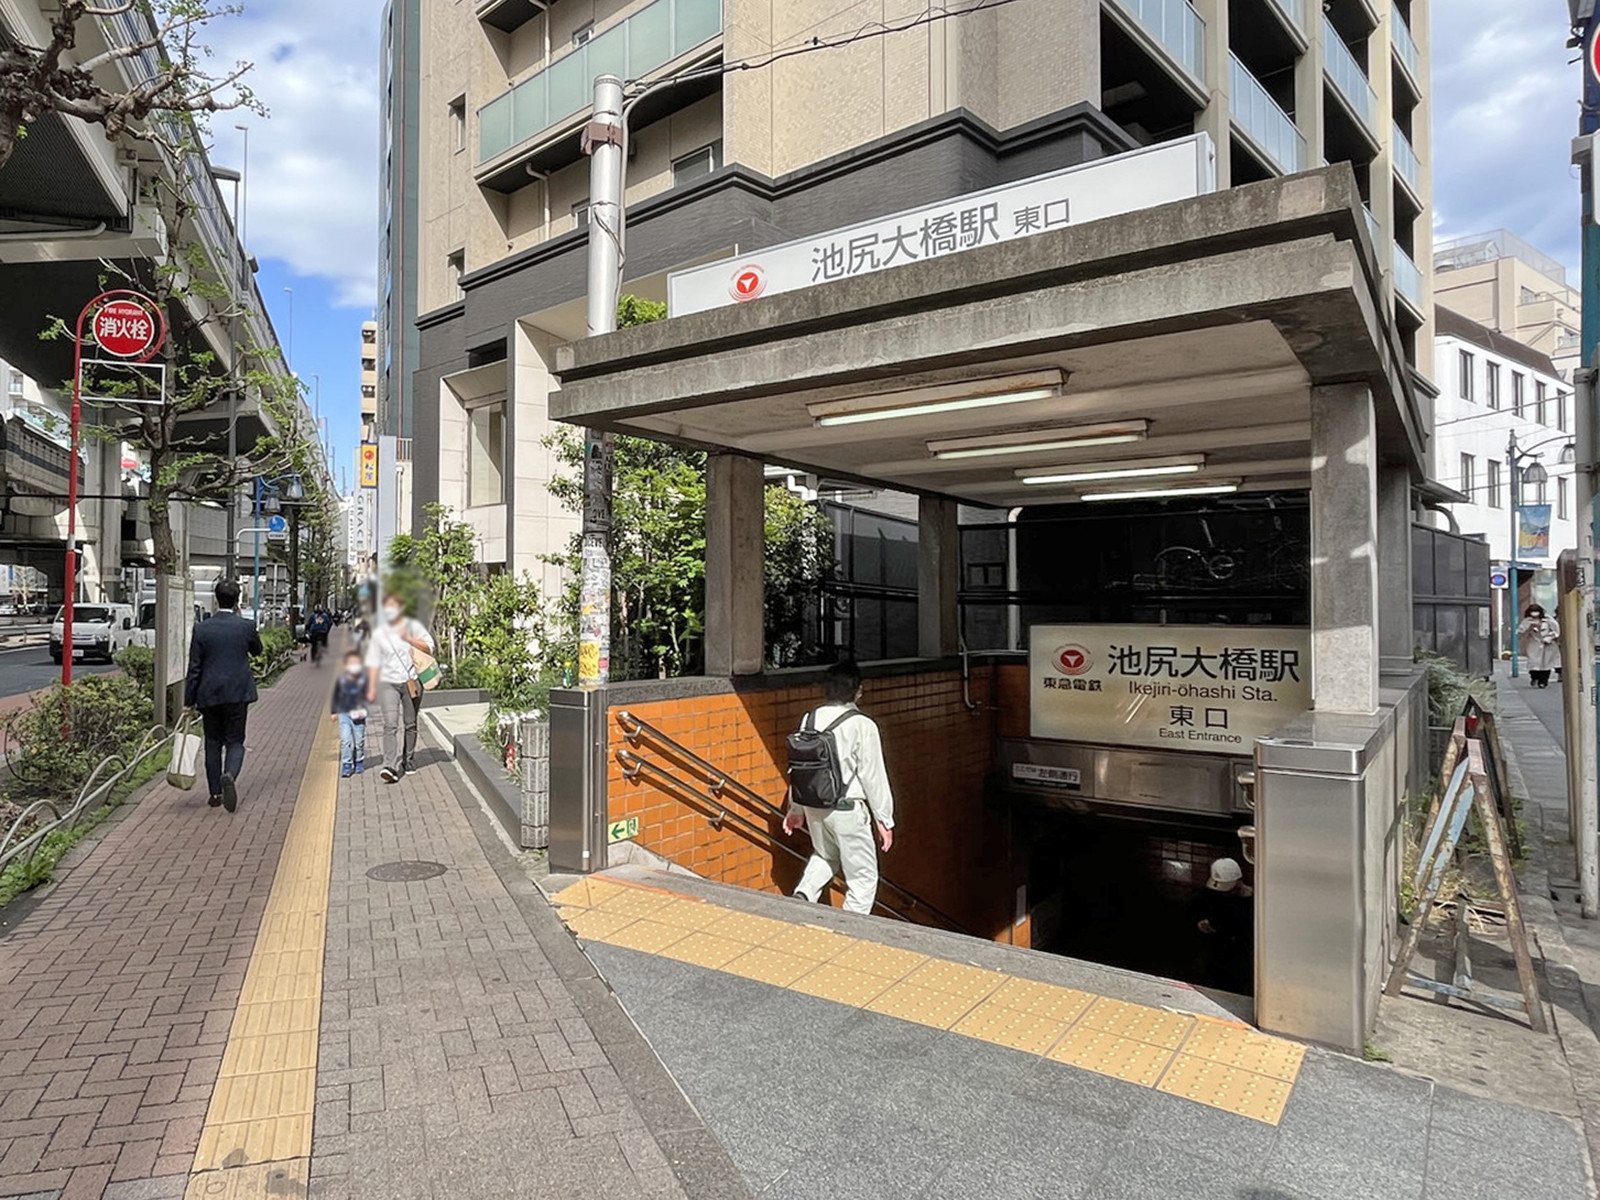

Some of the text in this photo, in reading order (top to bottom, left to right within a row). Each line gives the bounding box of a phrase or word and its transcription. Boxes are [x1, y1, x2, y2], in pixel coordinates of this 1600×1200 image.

[811, 198, 1071, 283] 池尻大橋駅 東口
[99, 316, 149, 340] 消火栓
[1107, 644, 1300, 683] 池尻大橋駅
[1043, 677, 1103, 692] 東急電鉄
[1242, 685, 1278, 702] Sta.
[1169, 704, 1229, 729] 東口
[1159, 728, 1242, 744] East Entrance
